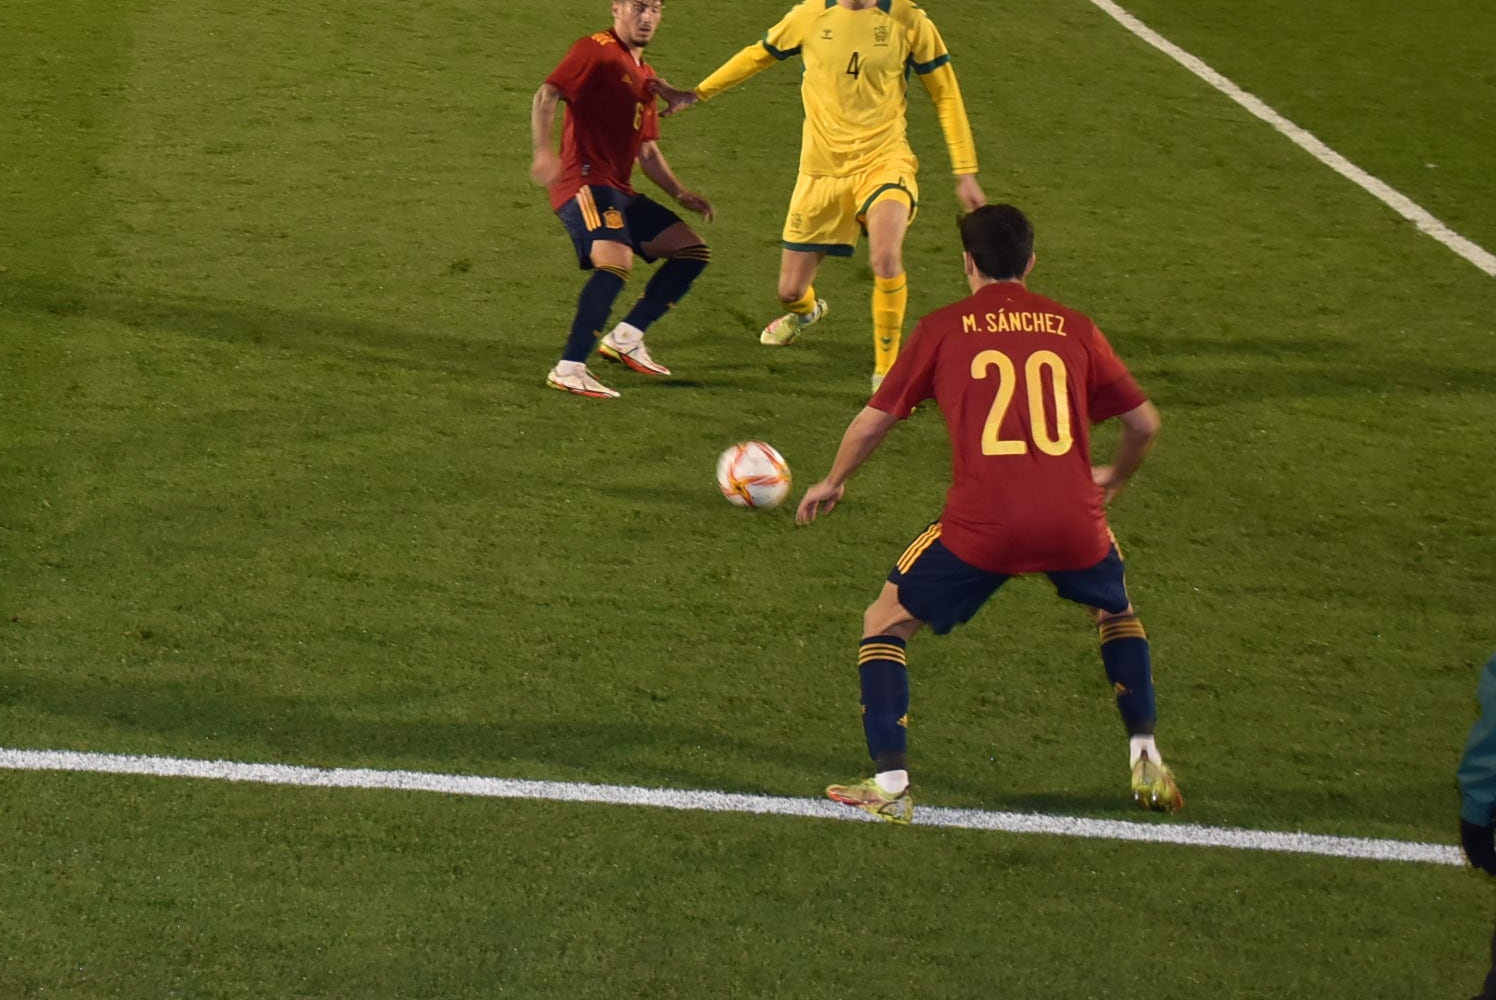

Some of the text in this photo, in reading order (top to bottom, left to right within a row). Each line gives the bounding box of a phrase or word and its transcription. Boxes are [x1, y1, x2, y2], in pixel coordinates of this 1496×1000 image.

[846, 51, 860, 80] 4
[961, 307, 1067, 337] M. SÁNCHEZ
[970, 349, 1074, 456] 20
